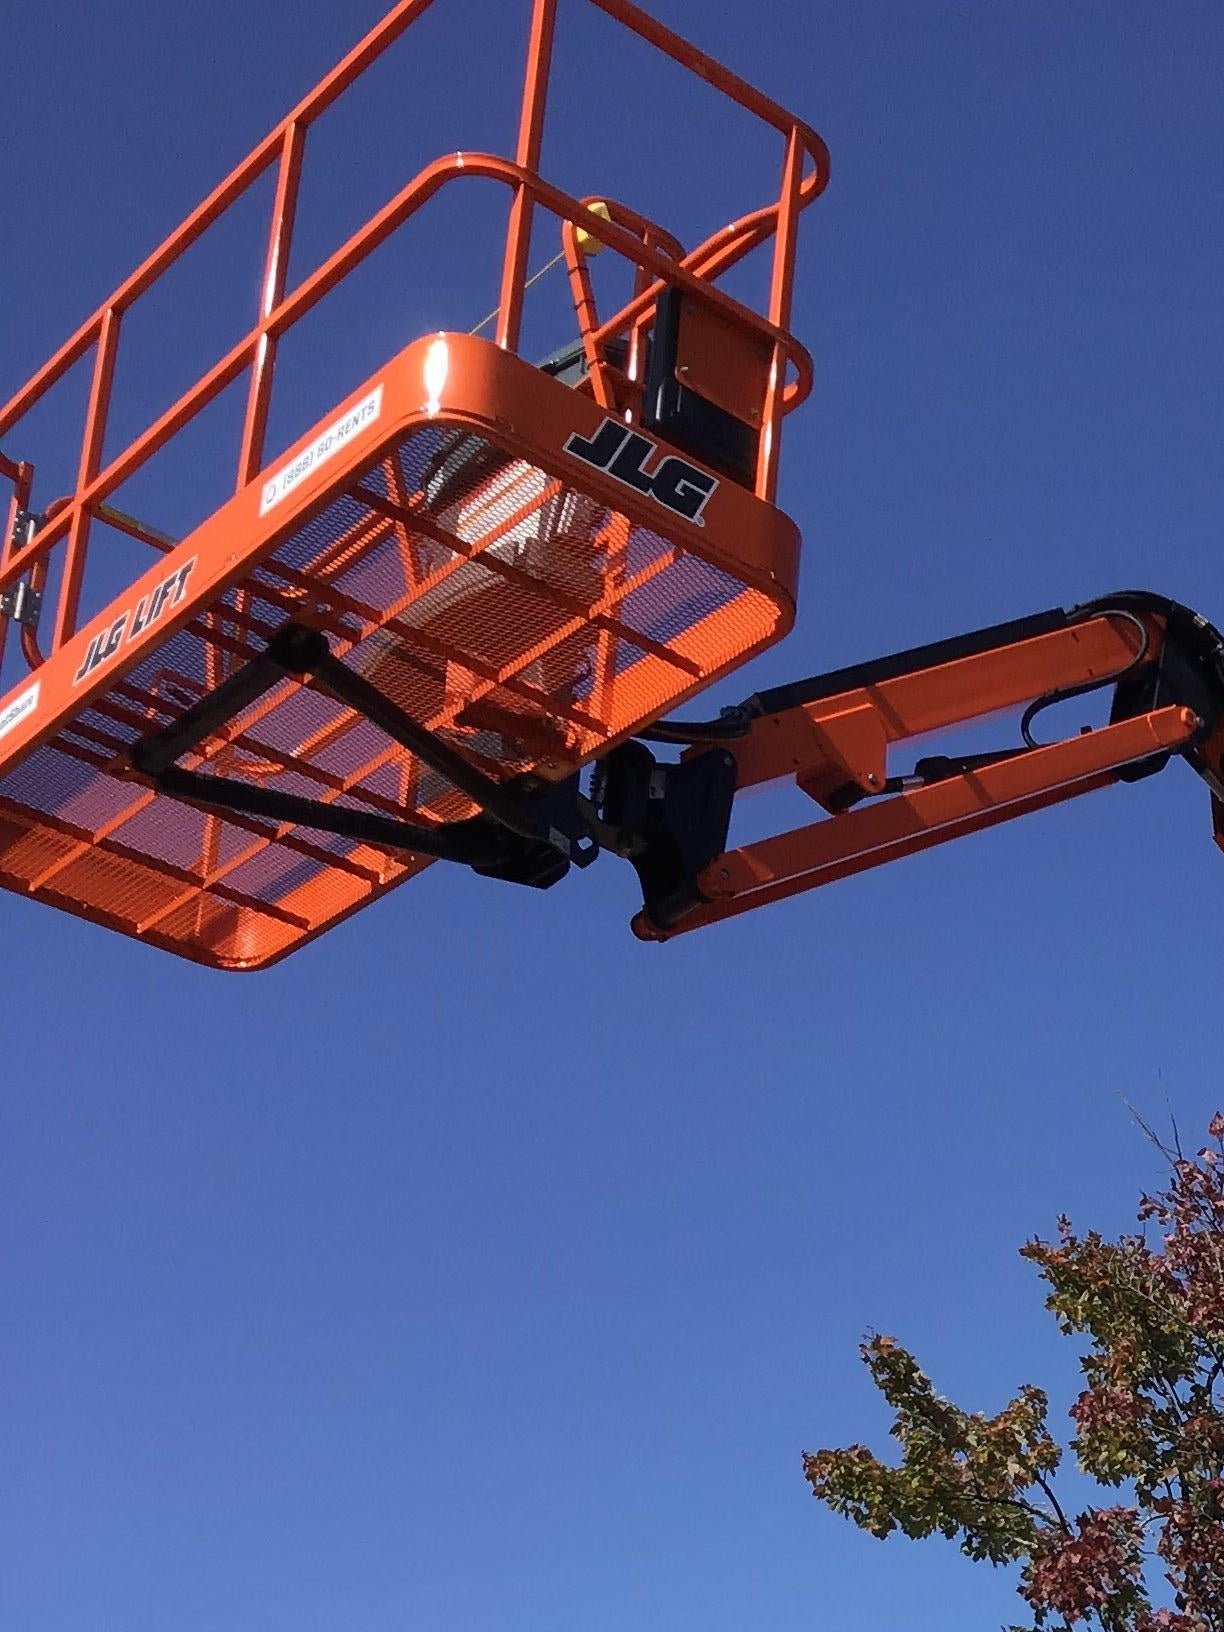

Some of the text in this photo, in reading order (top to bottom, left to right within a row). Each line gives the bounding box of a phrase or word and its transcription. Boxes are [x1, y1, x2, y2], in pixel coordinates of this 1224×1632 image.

[316, 399, 376, 459] 80-RENTS
[562, 416, 720, 524] JLG
[72, 554, 199, 688] JLG LIFT
